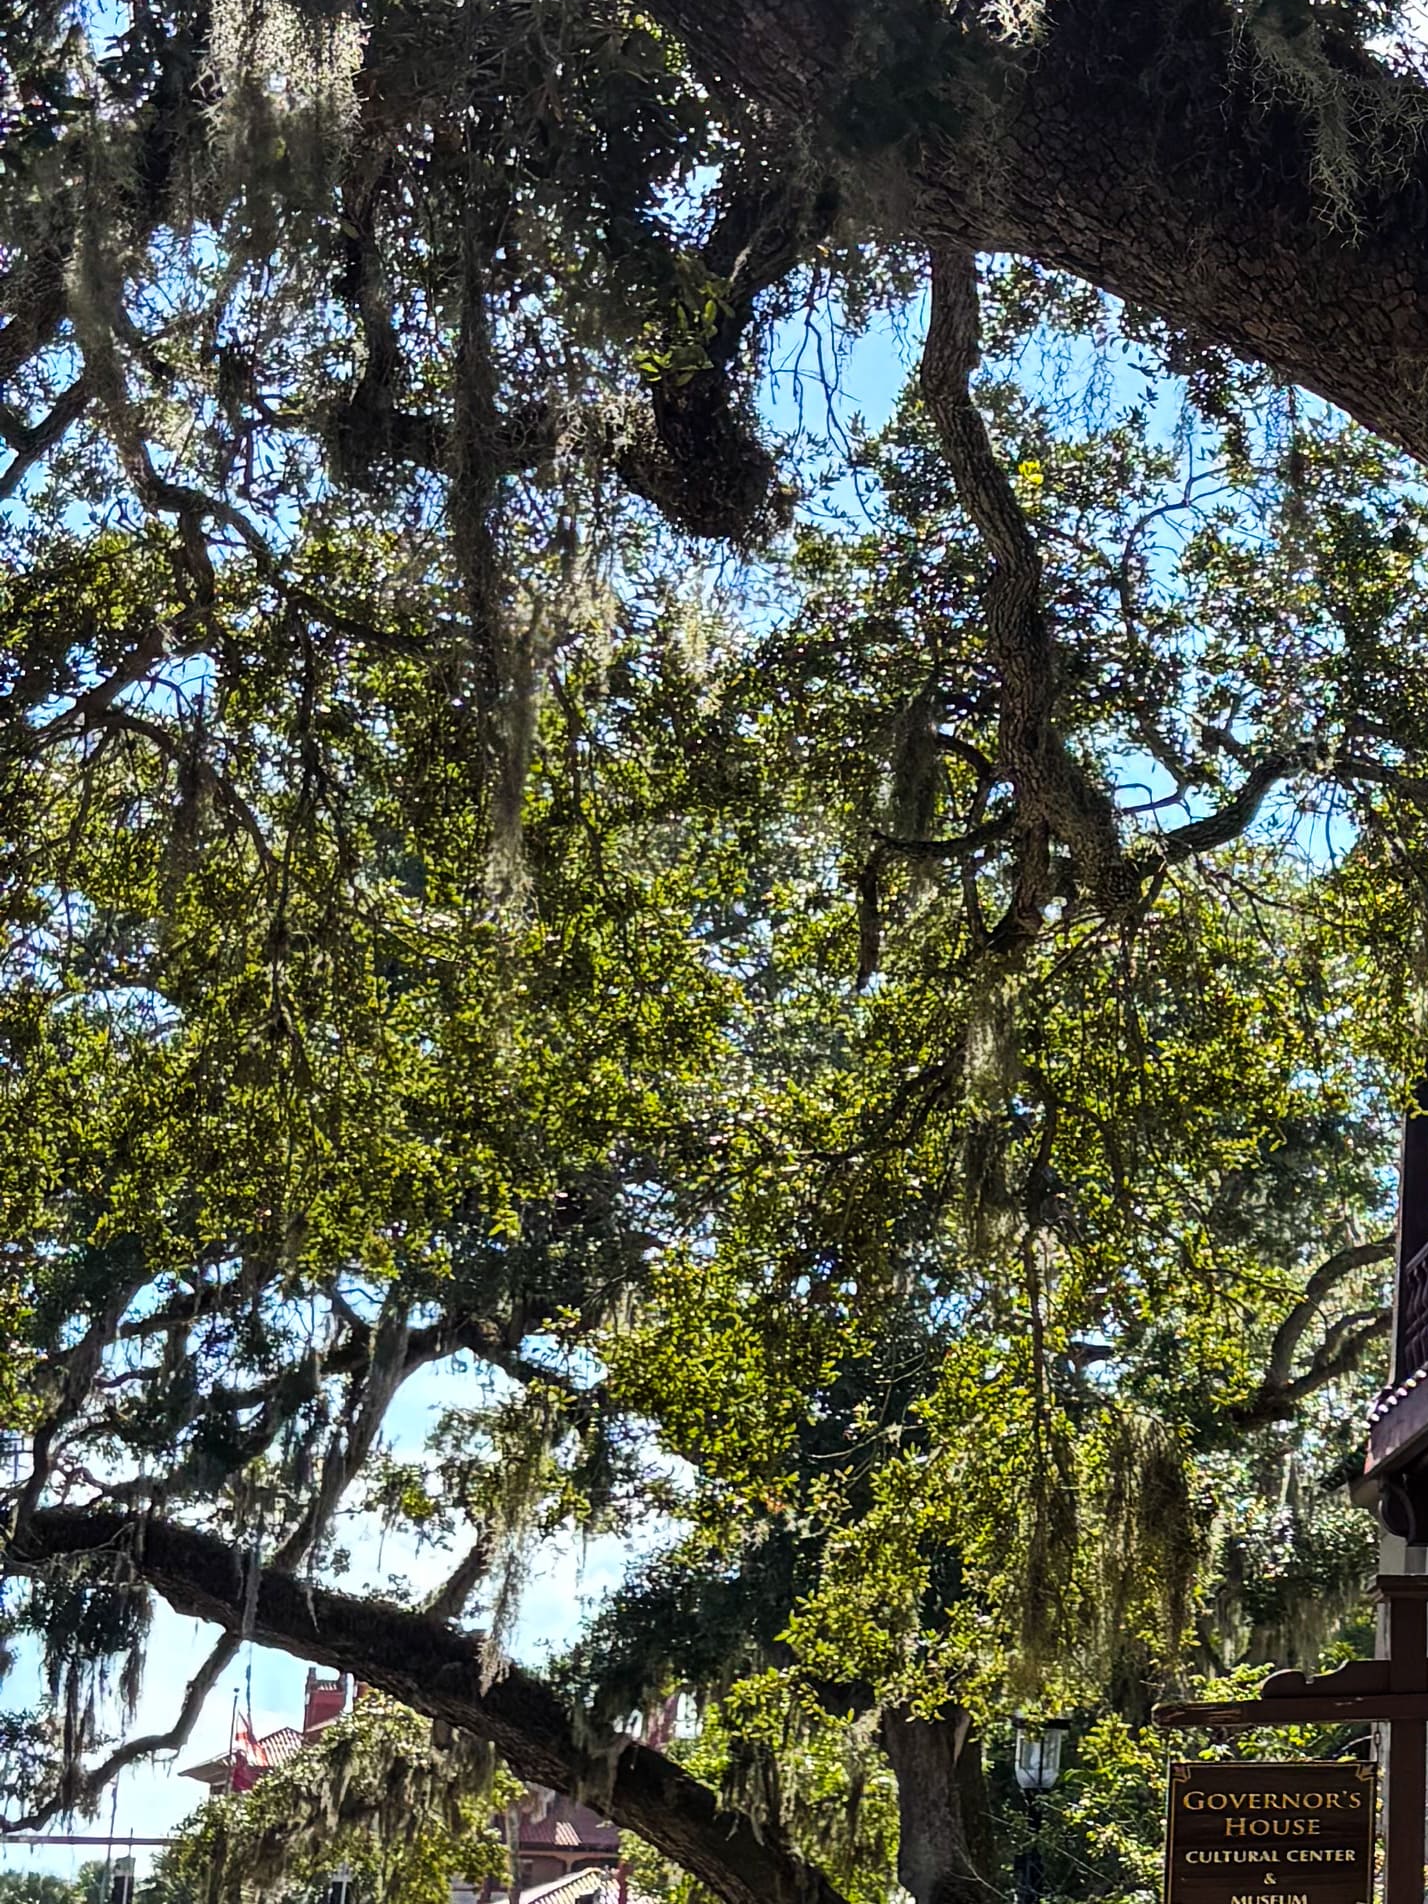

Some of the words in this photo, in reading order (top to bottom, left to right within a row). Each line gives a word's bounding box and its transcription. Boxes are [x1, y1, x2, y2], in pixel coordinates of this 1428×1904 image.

[1183, 1790, 1361, 1811] GOVERNOR'S
[1225, 1817, 1321, 1837] HOUSE
[1185, 1850, 1280, 1864] CULTURAL
[1286, 1849, 1356, 1862] CENTER
[1264, 1872, 1277, 1885] &
